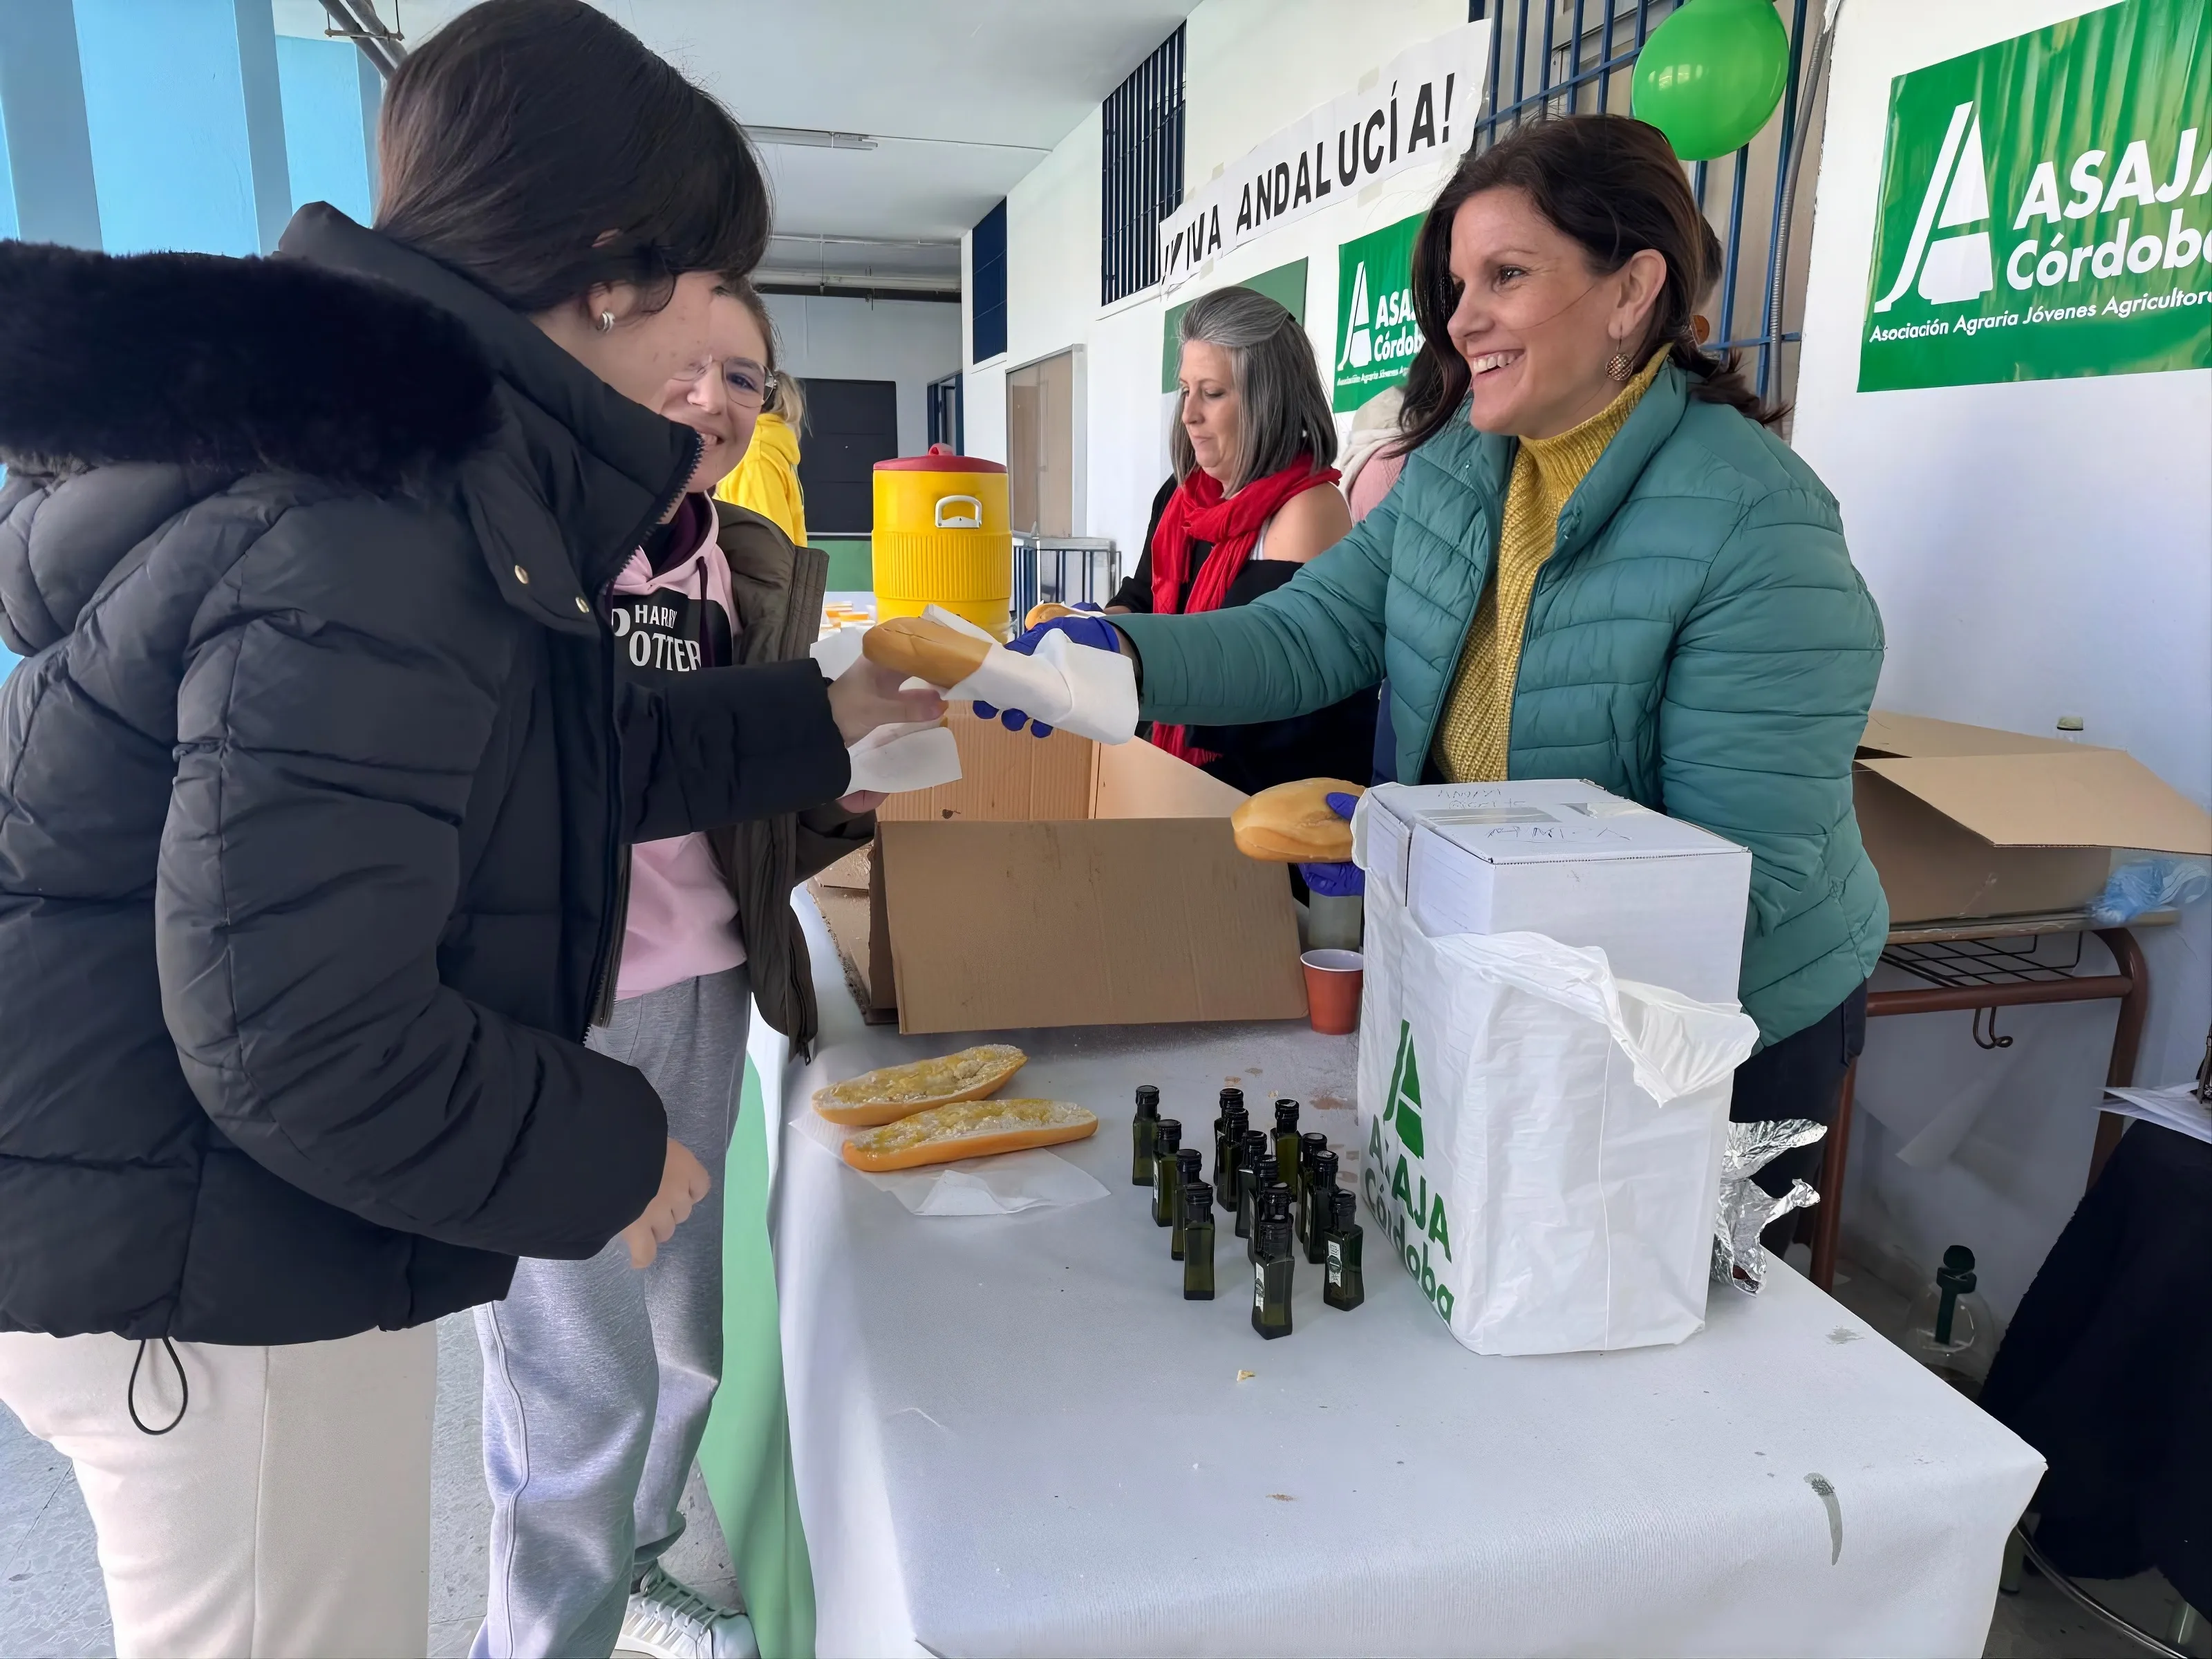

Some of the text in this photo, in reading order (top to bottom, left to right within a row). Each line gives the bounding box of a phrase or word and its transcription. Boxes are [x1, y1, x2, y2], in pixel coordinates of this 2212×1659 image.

[1236, 73, 1455, 234] ANDALUCÍA!
[1375, 288, 1416, 330] ASA
[1869, 317, 1949, 343] Asociación
[1953, 310, 2018, 337] Agraria
[2022, 304, 2097, 326] Jóvenes
[1369, 1114, 1452, 1264] AAJA
